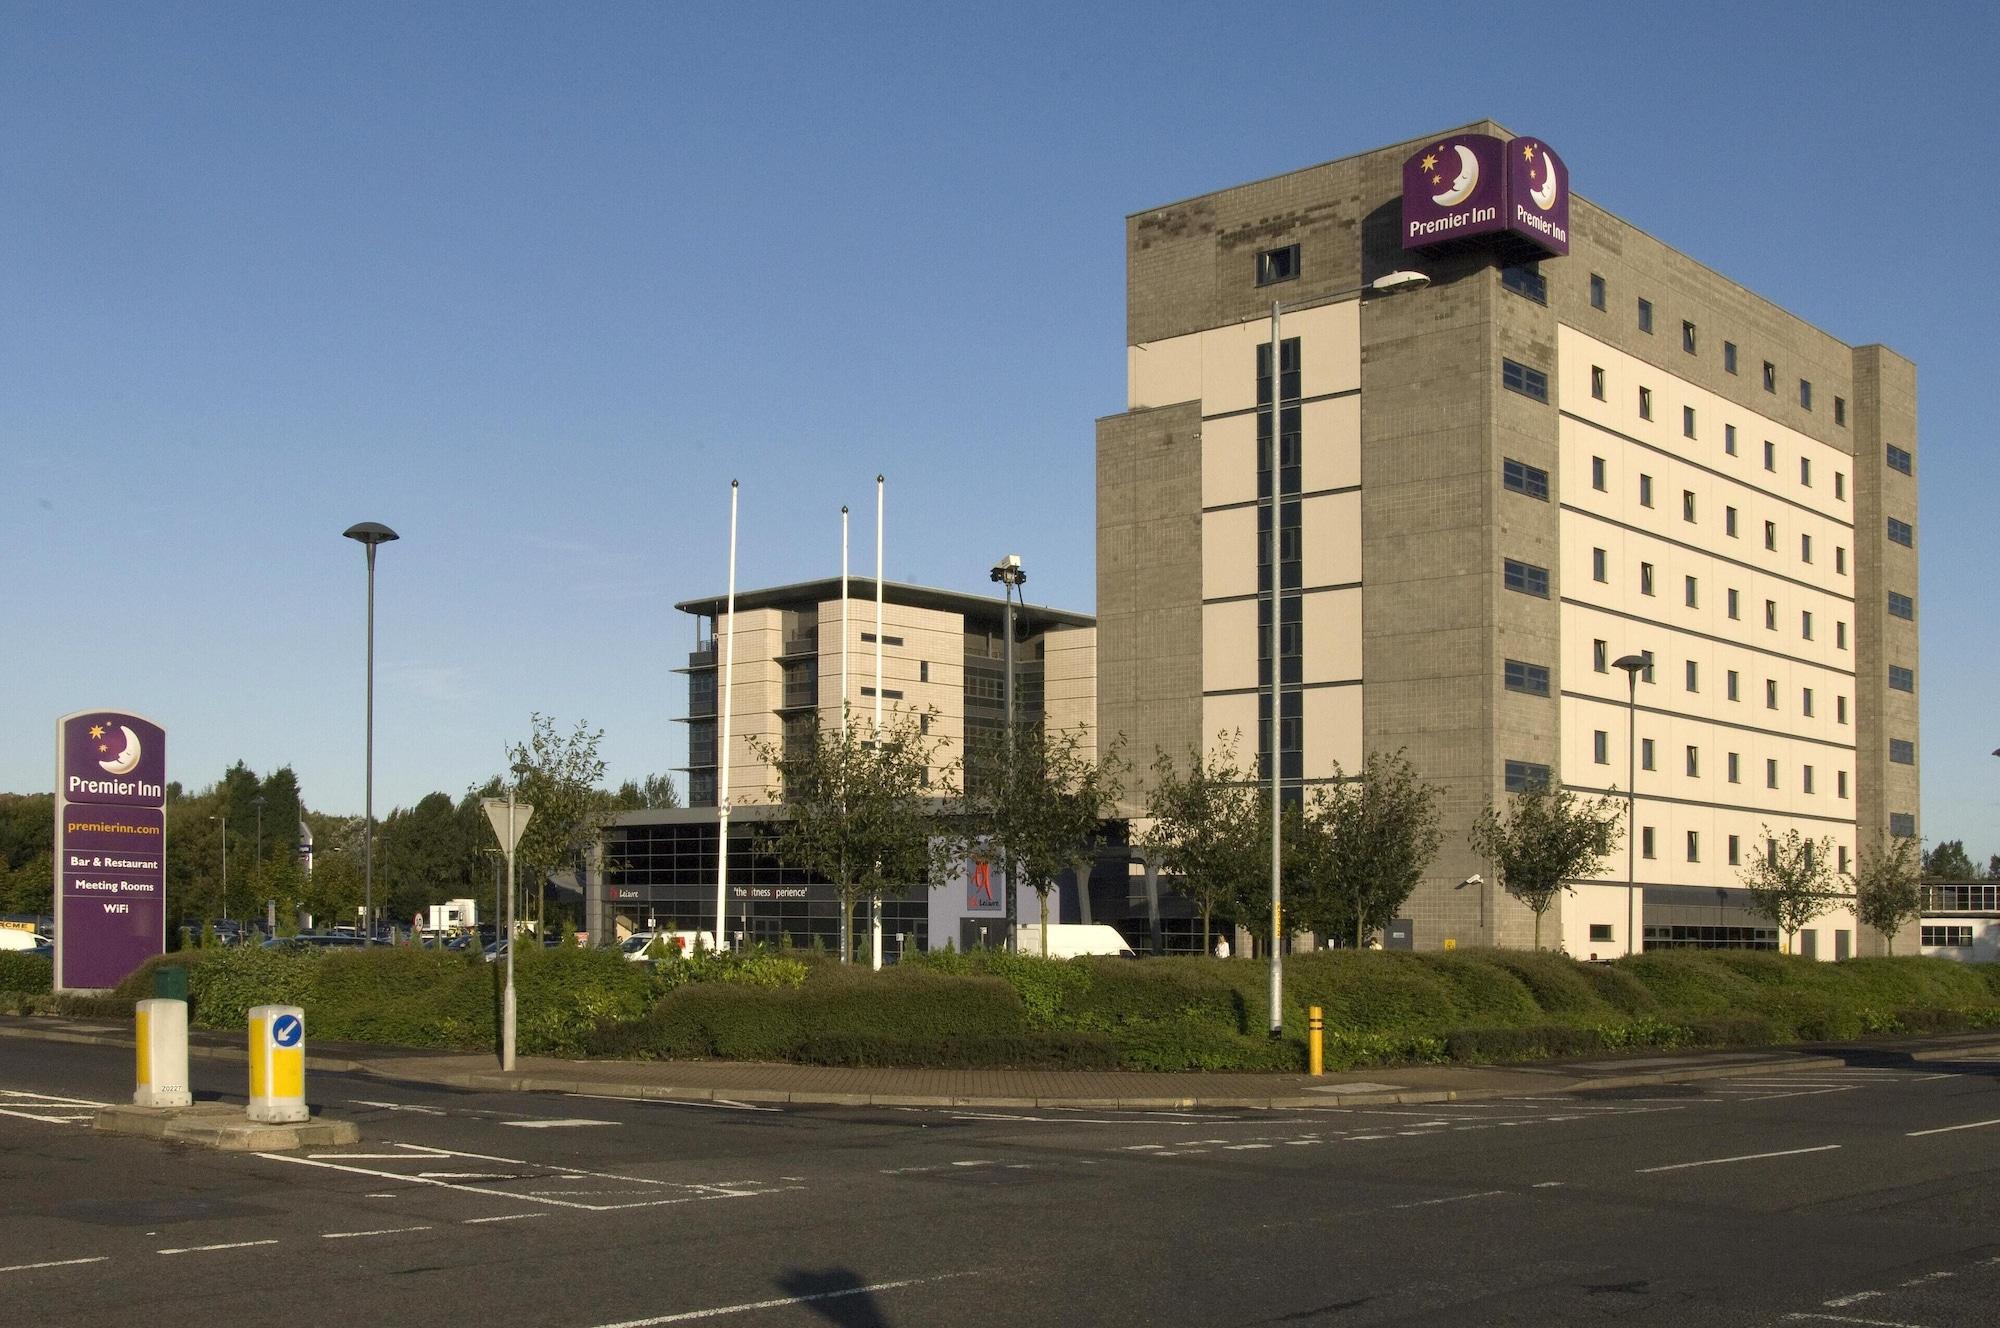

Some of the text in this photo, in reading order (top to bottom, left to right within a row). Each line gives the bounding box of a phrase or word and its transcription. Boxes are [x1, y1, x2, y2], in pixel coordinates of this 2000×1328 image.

[1409, 206, 1496, 238] Premier Inn
[1517, 204, 1566, 243] Premier Inn
[69, 775, 161, 798] Premier Inn
[68, 821, 160, 835] premierinn.com
[70, 856, 159, 869] Bar & Restaurant
[75, 879, 154, 893] Meeting Rooms
[103, 903, 129, 914] WiFi
